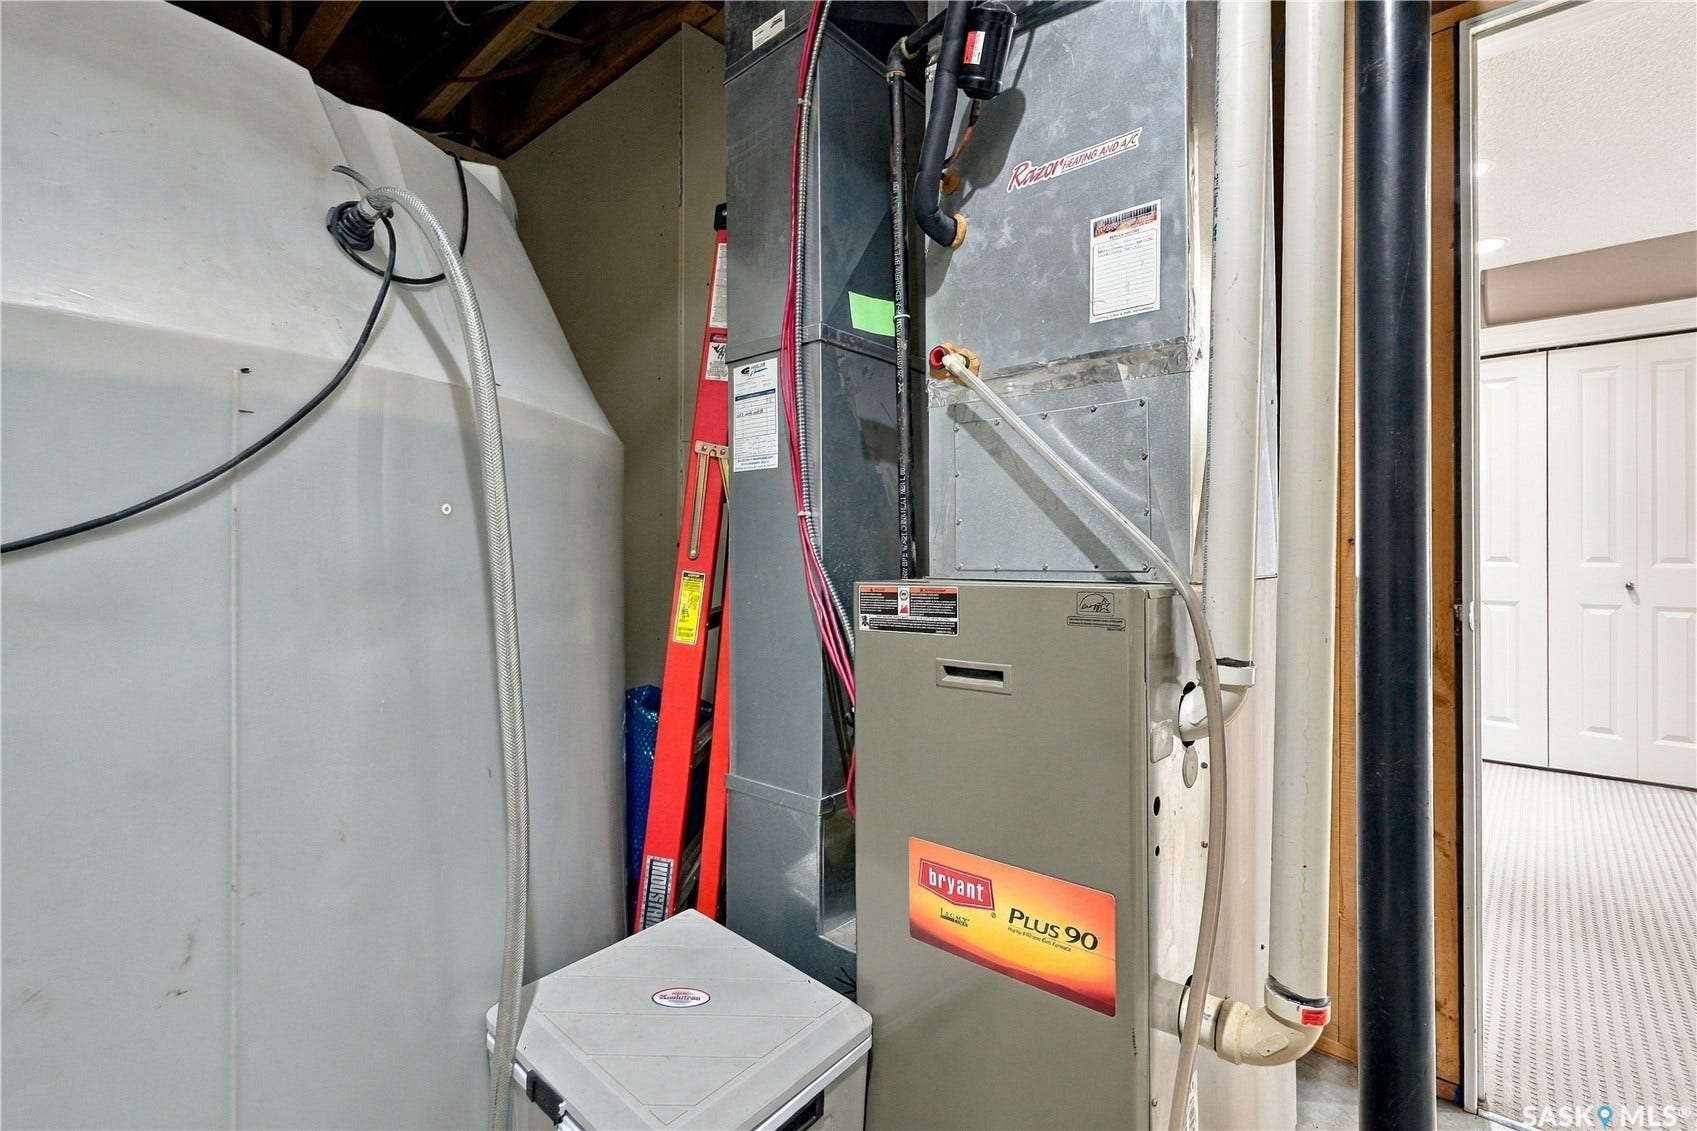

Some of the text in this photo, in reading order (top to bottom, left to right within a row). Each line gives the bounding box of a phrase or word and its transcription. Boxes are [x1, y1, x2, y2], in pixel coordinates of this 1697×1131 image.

[1008, 133, 1139, 191] Razor HEATING AND A/C
[928, 867, 984, 902] bryant
[1008, 907, 1099, 951] PLUS 90
